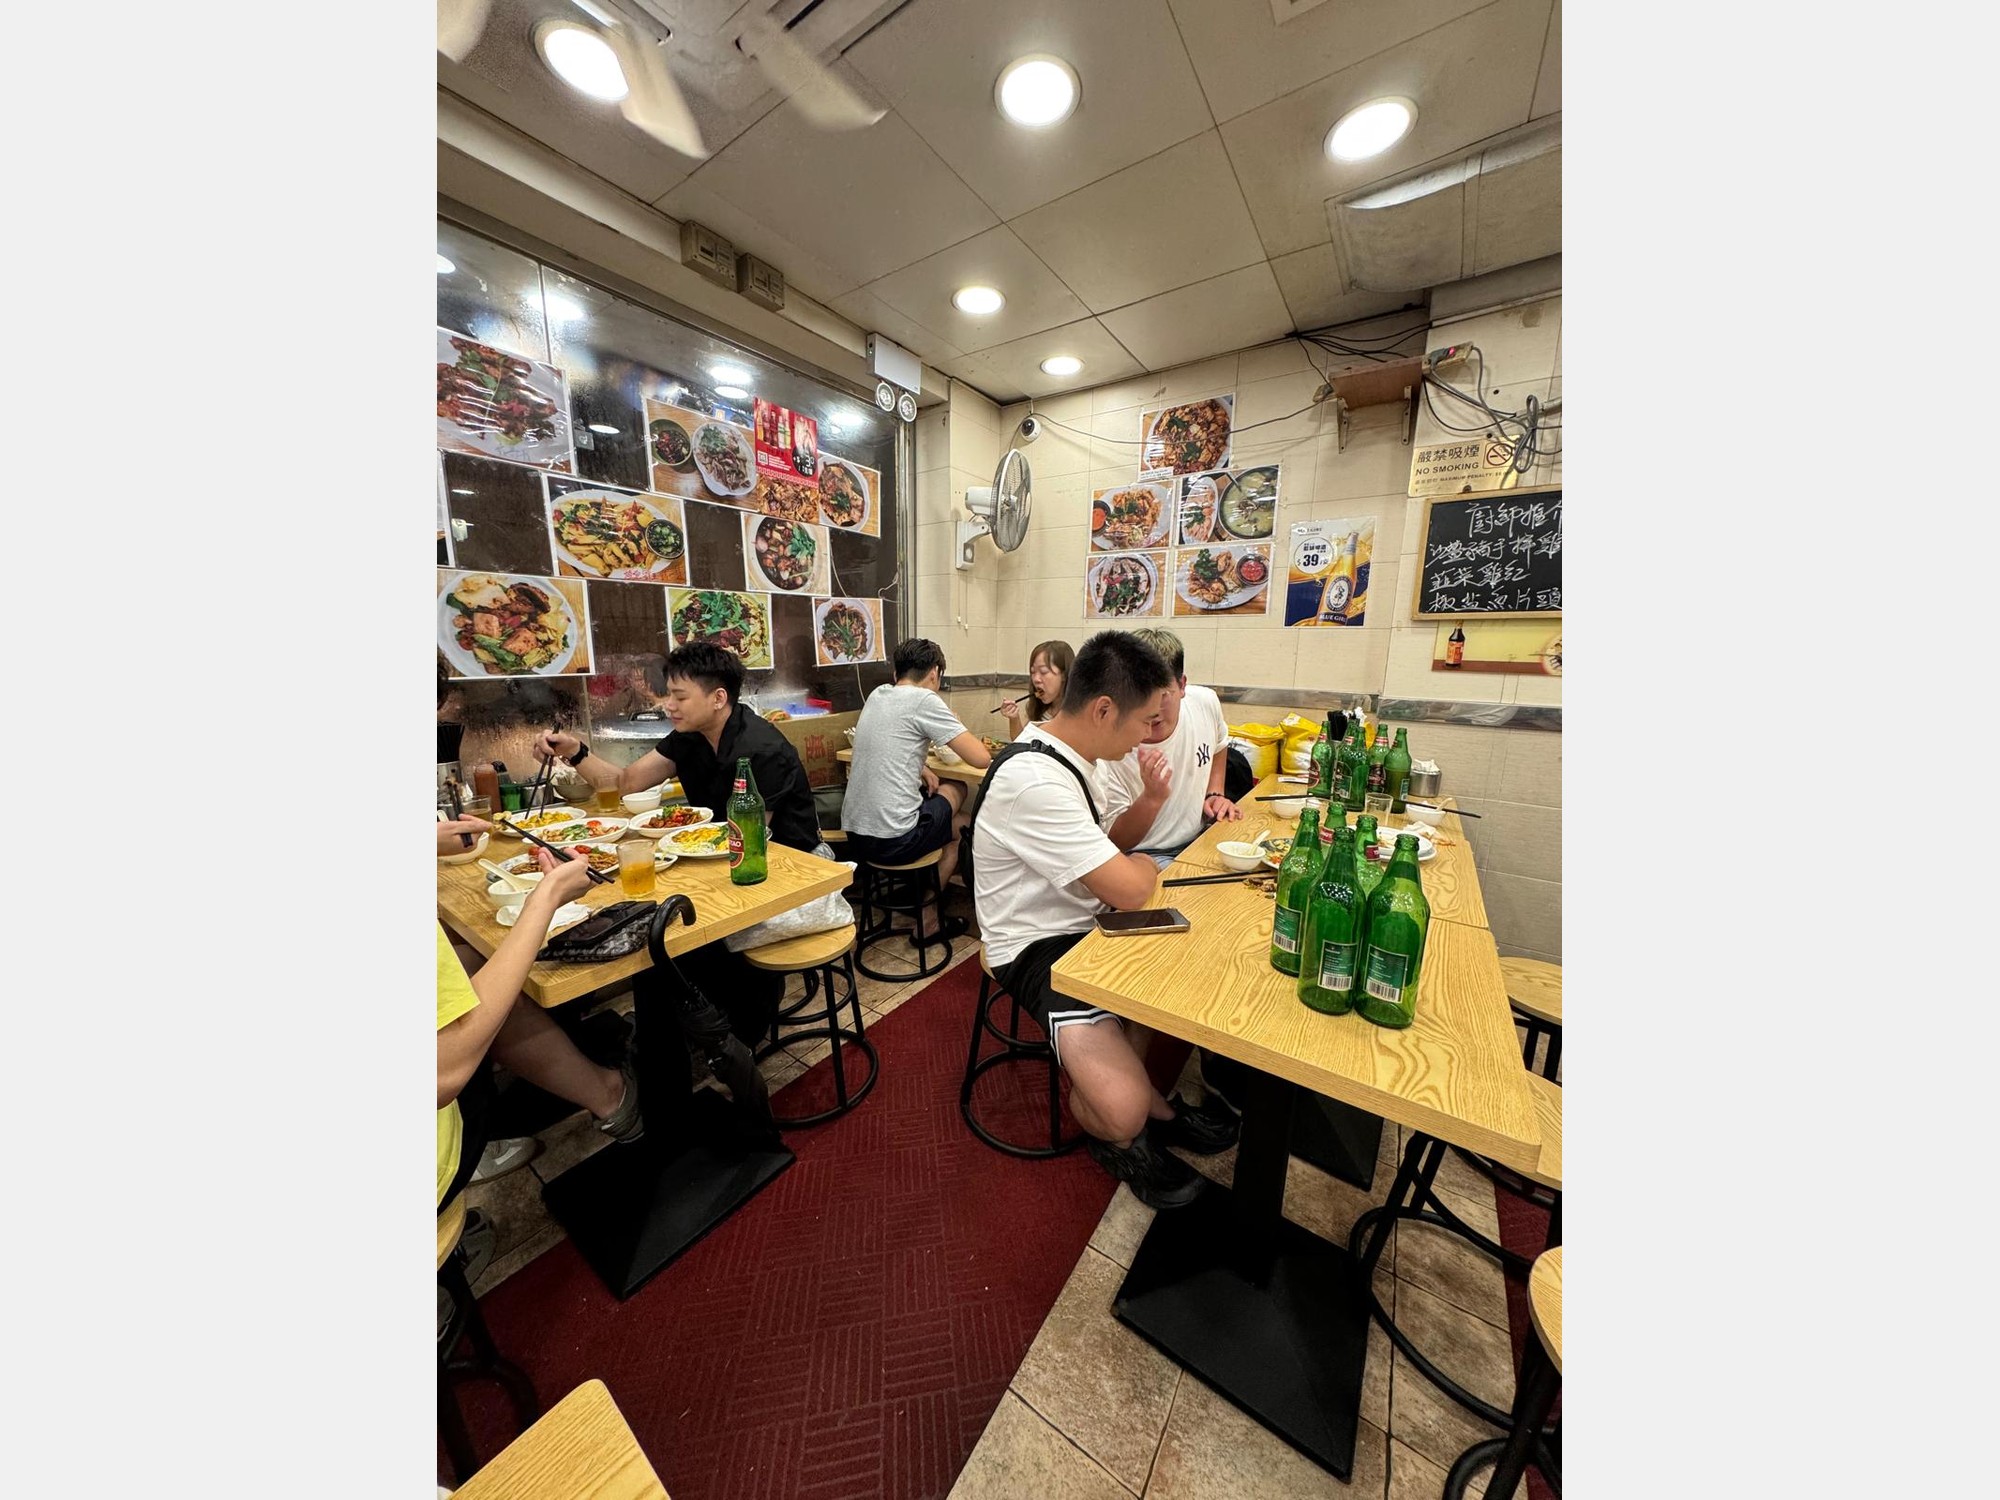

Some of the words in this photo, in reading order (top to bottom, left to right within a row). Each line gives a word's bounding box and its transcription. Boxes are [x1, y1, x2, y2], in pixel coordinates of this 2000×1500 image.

[1417, 444, 1480, 463] 嚴禁吸煙
[1416, 467, 1429, 476] NO
[1432, 462, 1479, 473] SMOKING
